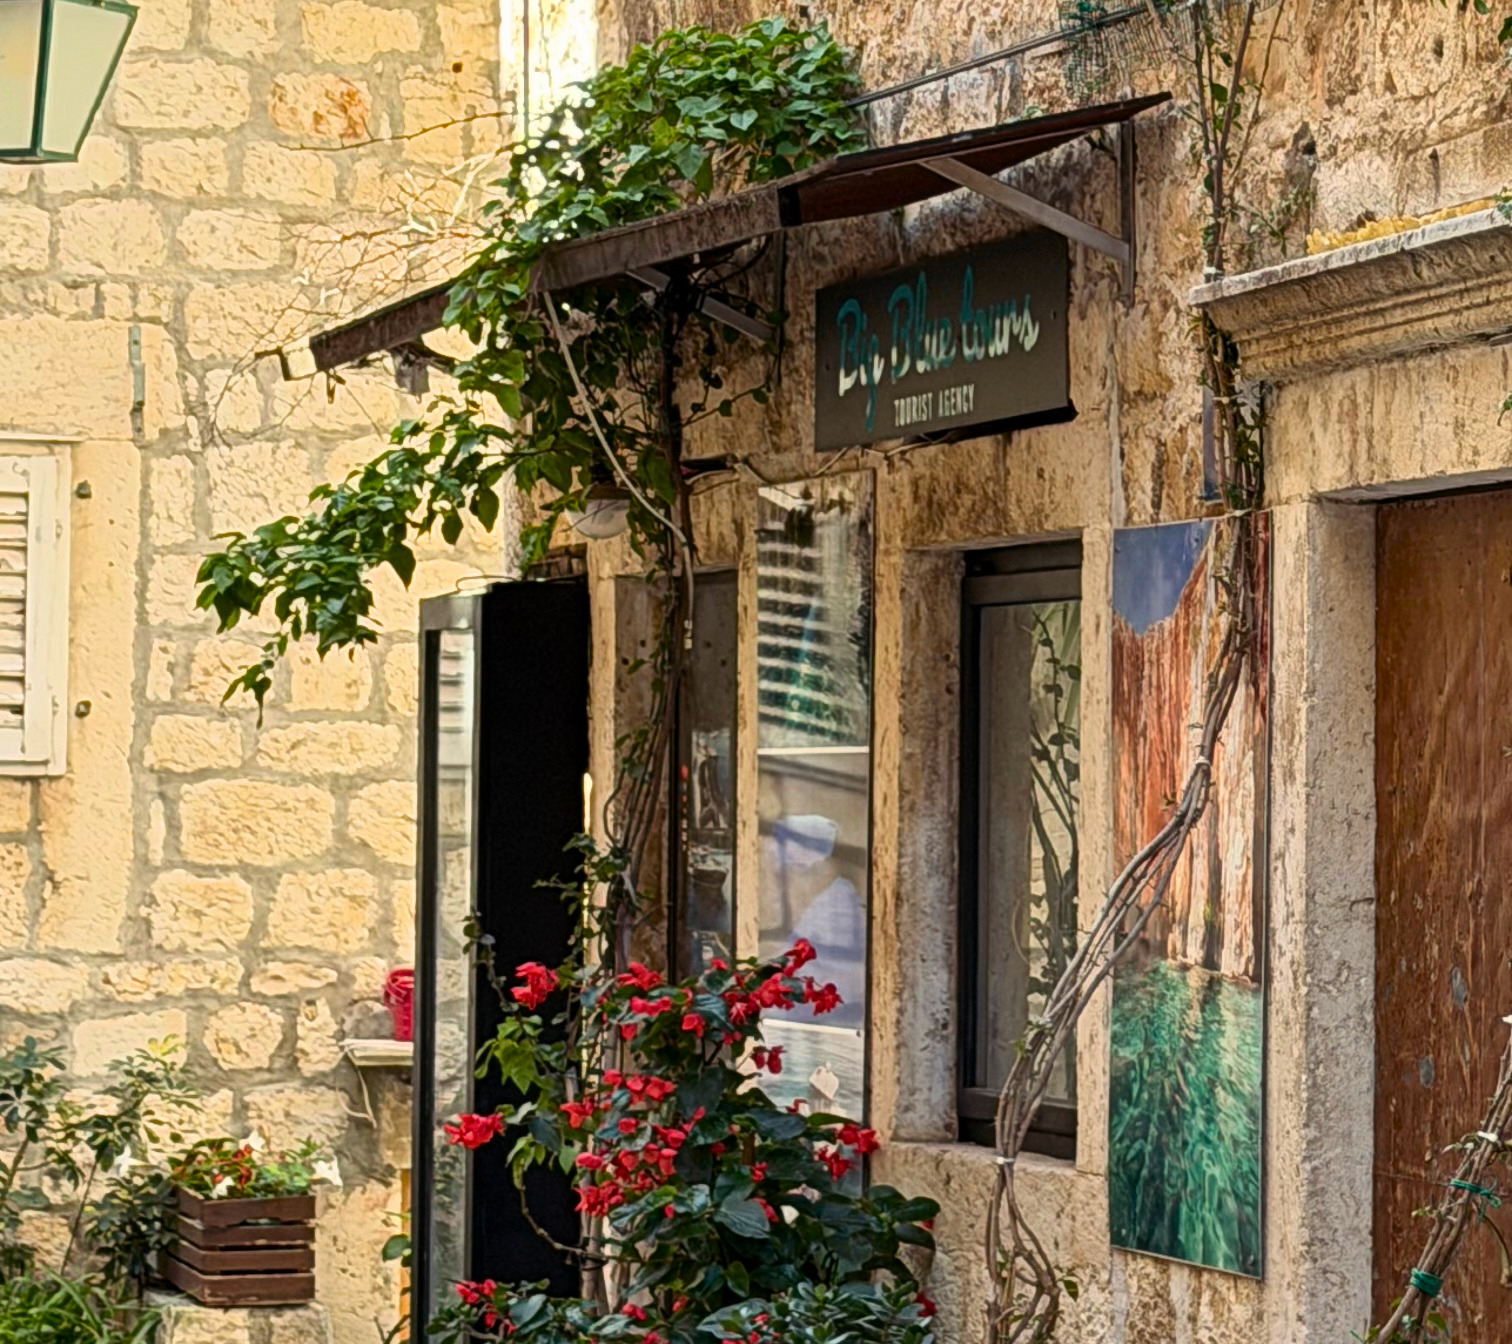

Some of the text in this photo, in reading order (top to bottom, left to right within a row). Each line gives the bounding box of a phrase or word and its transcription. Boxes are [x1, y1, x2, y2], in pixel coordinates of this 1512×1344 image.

[836, 298, 886, 433] Big
[887, 269, 957, 385] Blue
[893, 383, 976, 428] TOURIST AGENCY
